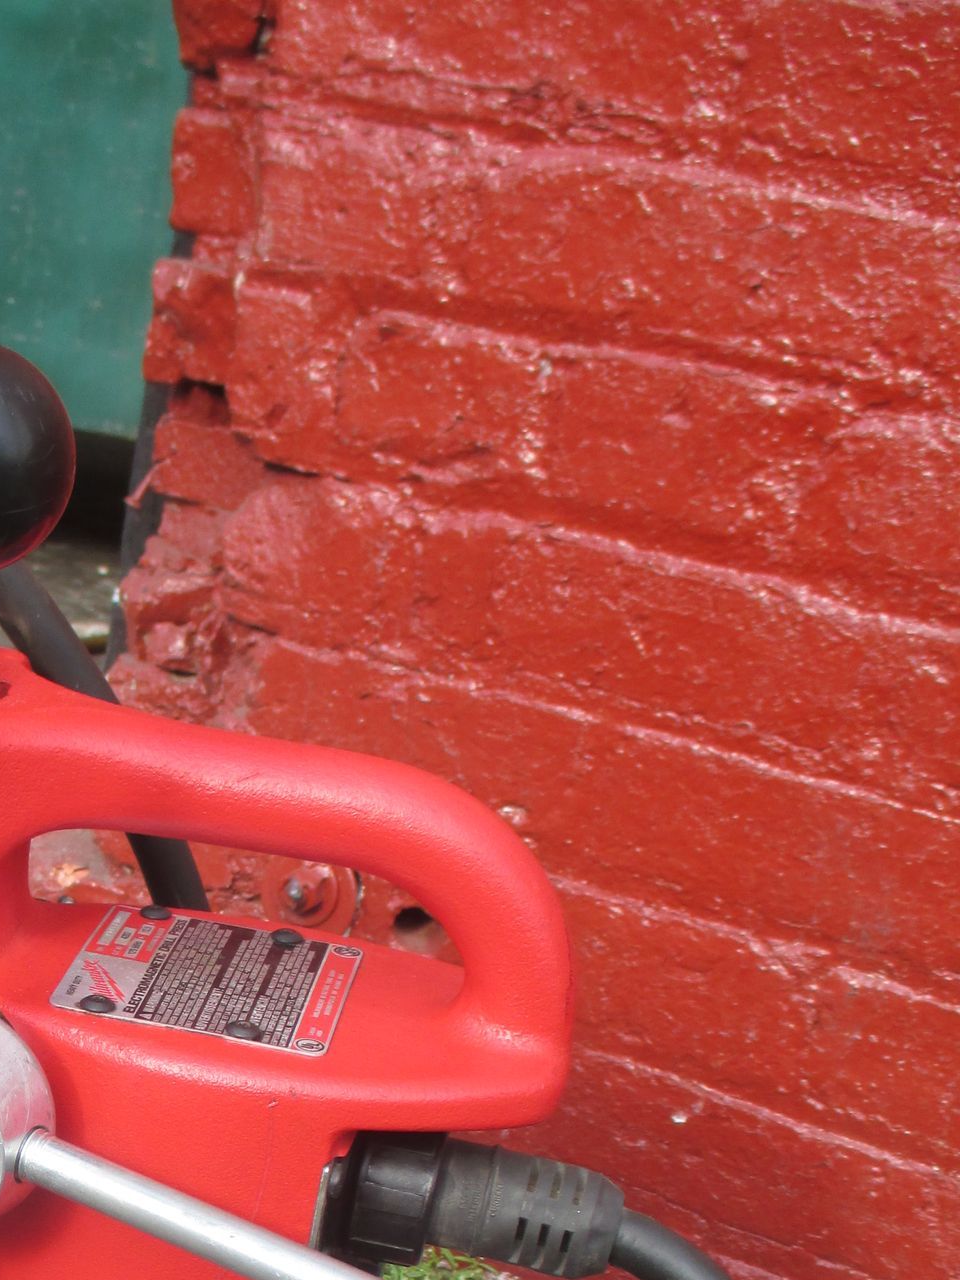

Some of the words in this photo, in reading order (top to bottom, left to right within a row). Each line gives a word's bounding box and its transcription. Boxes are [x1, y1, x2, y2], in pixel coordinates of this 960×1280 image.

[167, 919, 188, 936] PRESS
[158, 935, 177, 952] DRILL
[123, 953, 165, 1013] ELECTROMAGNETIC
